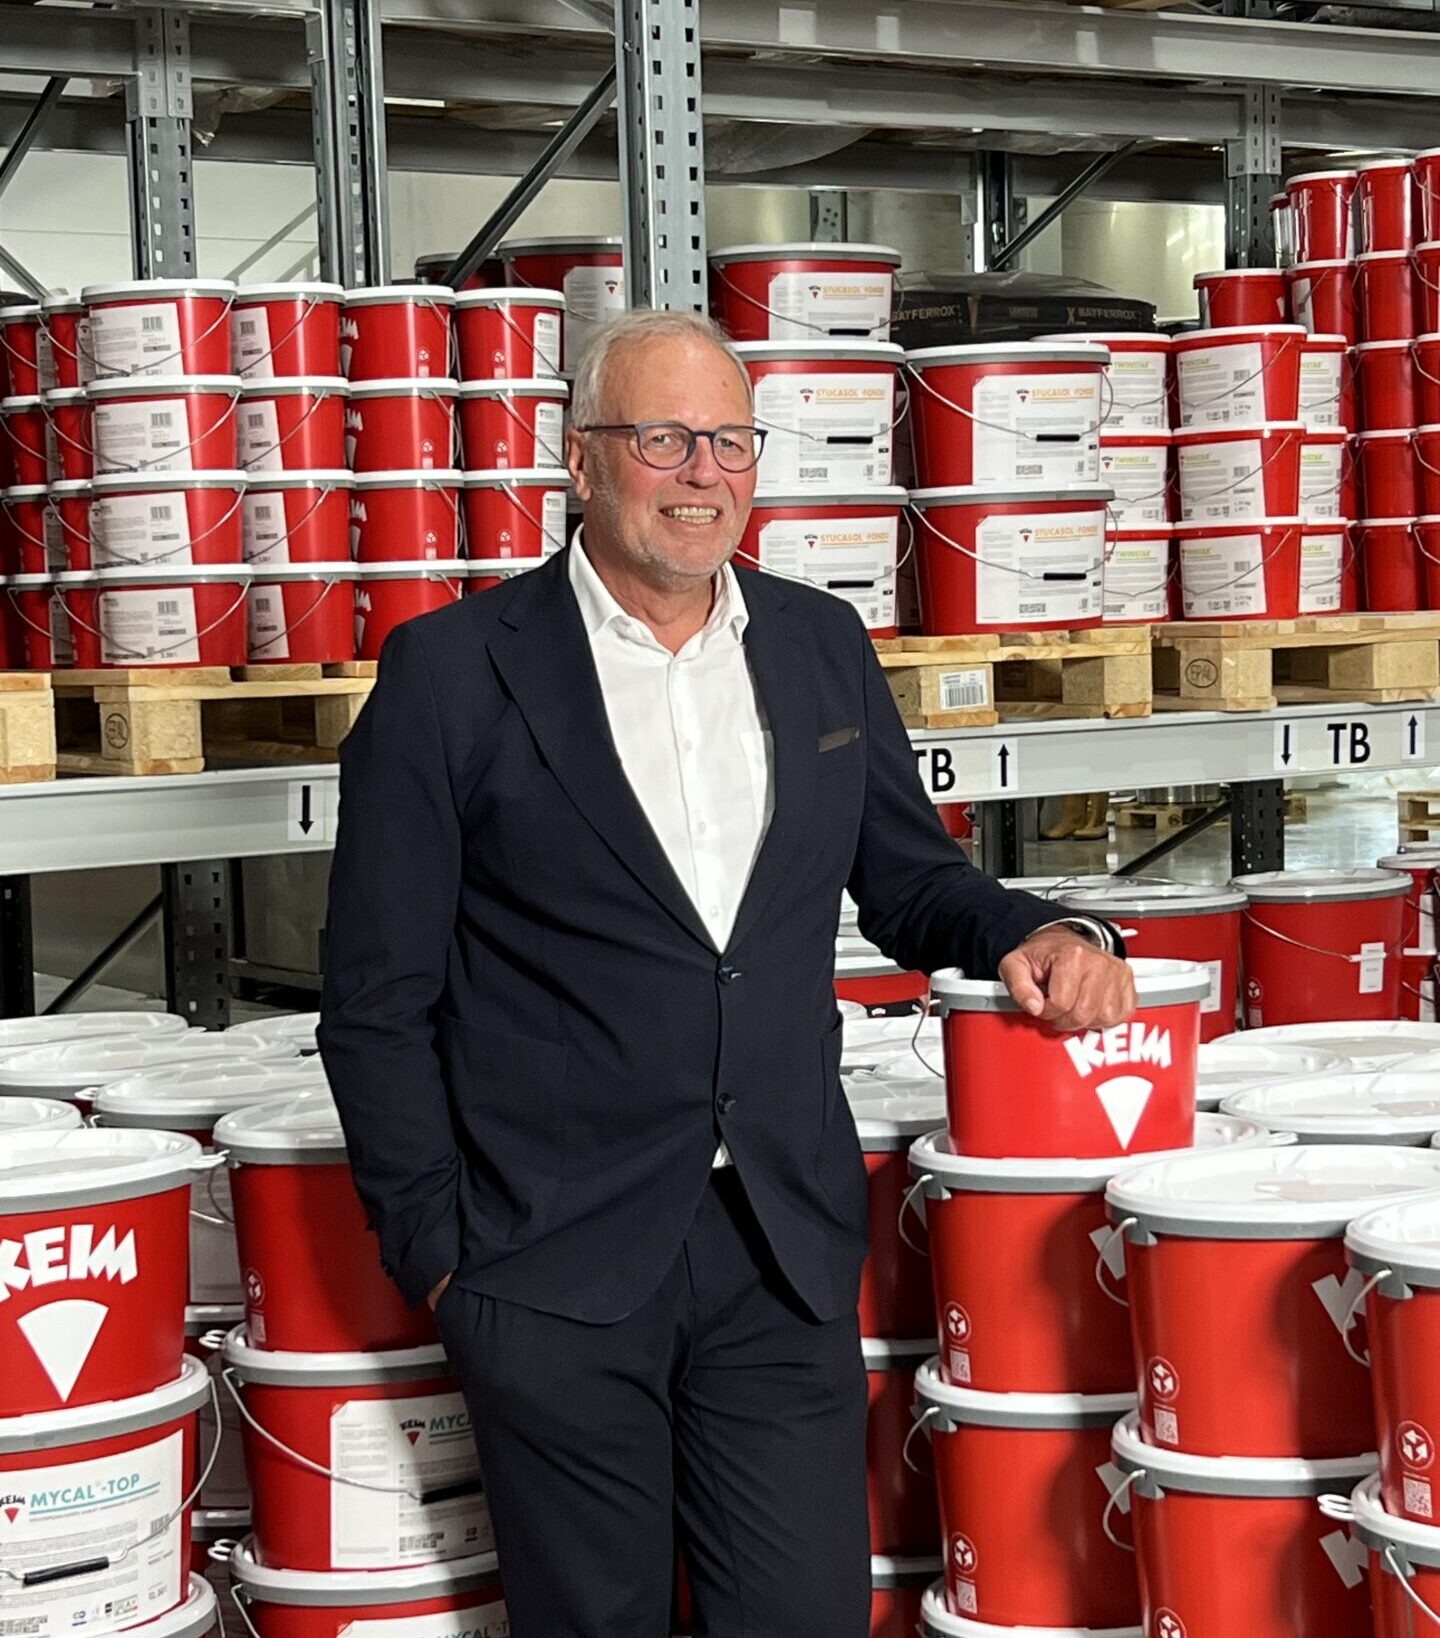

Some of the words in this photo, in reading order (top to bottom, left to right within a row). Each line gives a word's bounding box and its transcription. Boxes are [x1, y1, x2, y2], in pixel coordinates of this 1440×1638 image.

[1327, 722, 1371, 764] TB
[1063, 1022, 1173, 1078] KEIM
[430, 1413, 471, 1432] MYC
